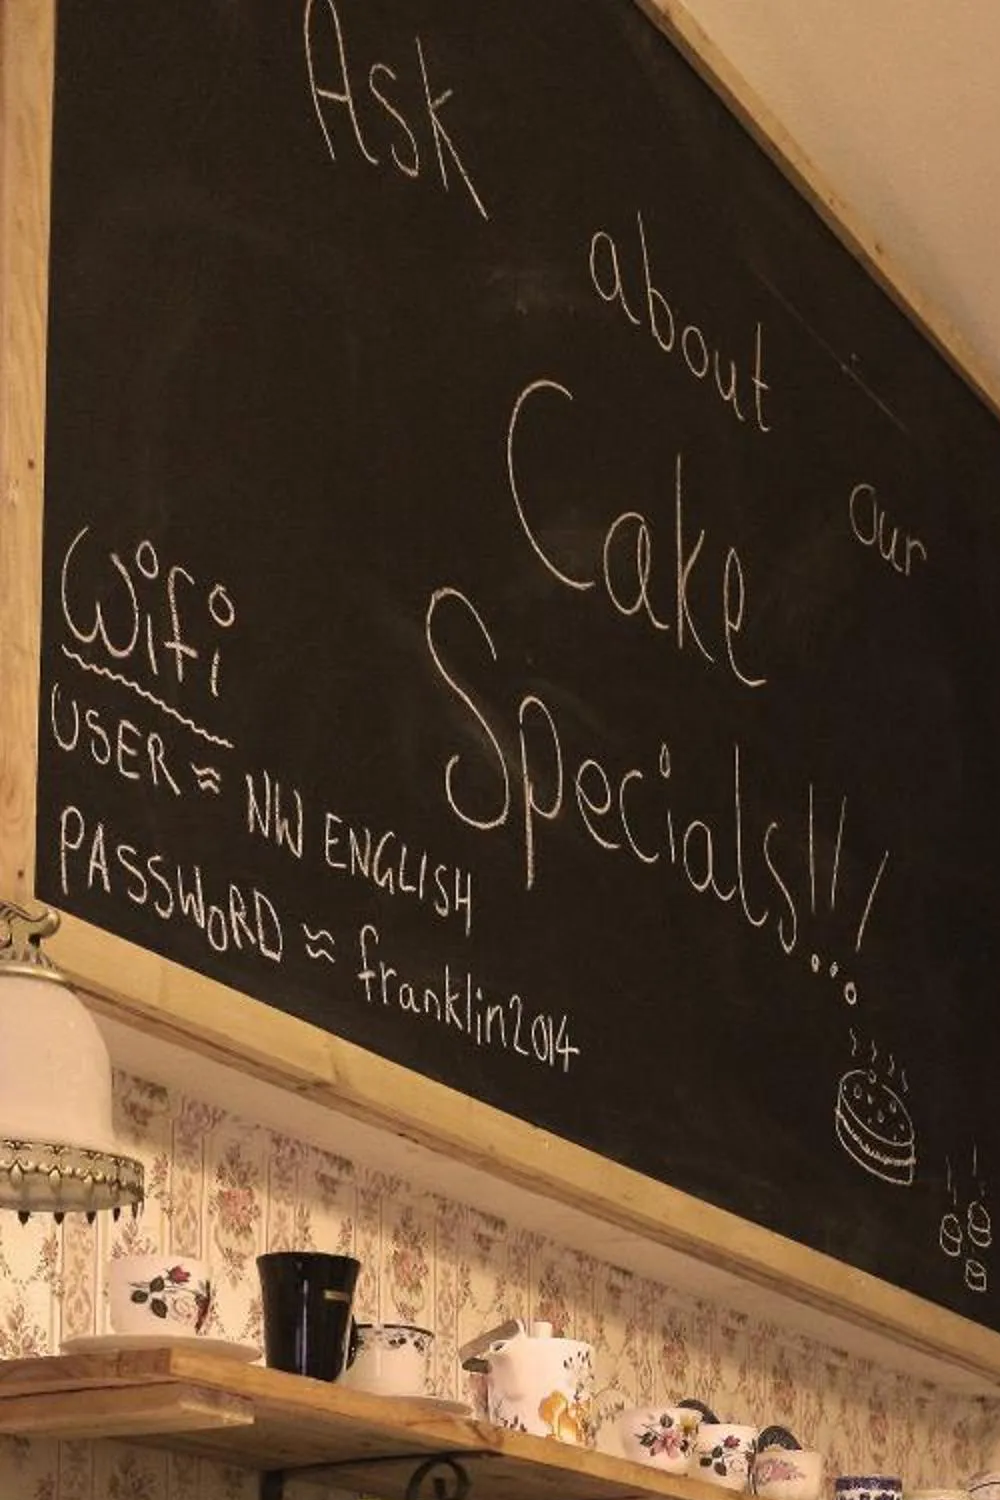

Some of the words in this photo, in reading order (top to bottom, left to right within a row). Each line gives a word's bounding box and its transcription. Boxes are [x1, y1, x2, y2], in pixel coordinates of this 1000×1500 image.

[303, 0, 489, 220] Ask
[589, 211, 771, 432] about
[62, 526, 235, 695] Wifi
[507, 380, 766, 687] Cake
[51, 683, 181, 796] USER
[325, 812, 473, 936] ENGLISH
[358, 924, 580, 1073] franklin2014
